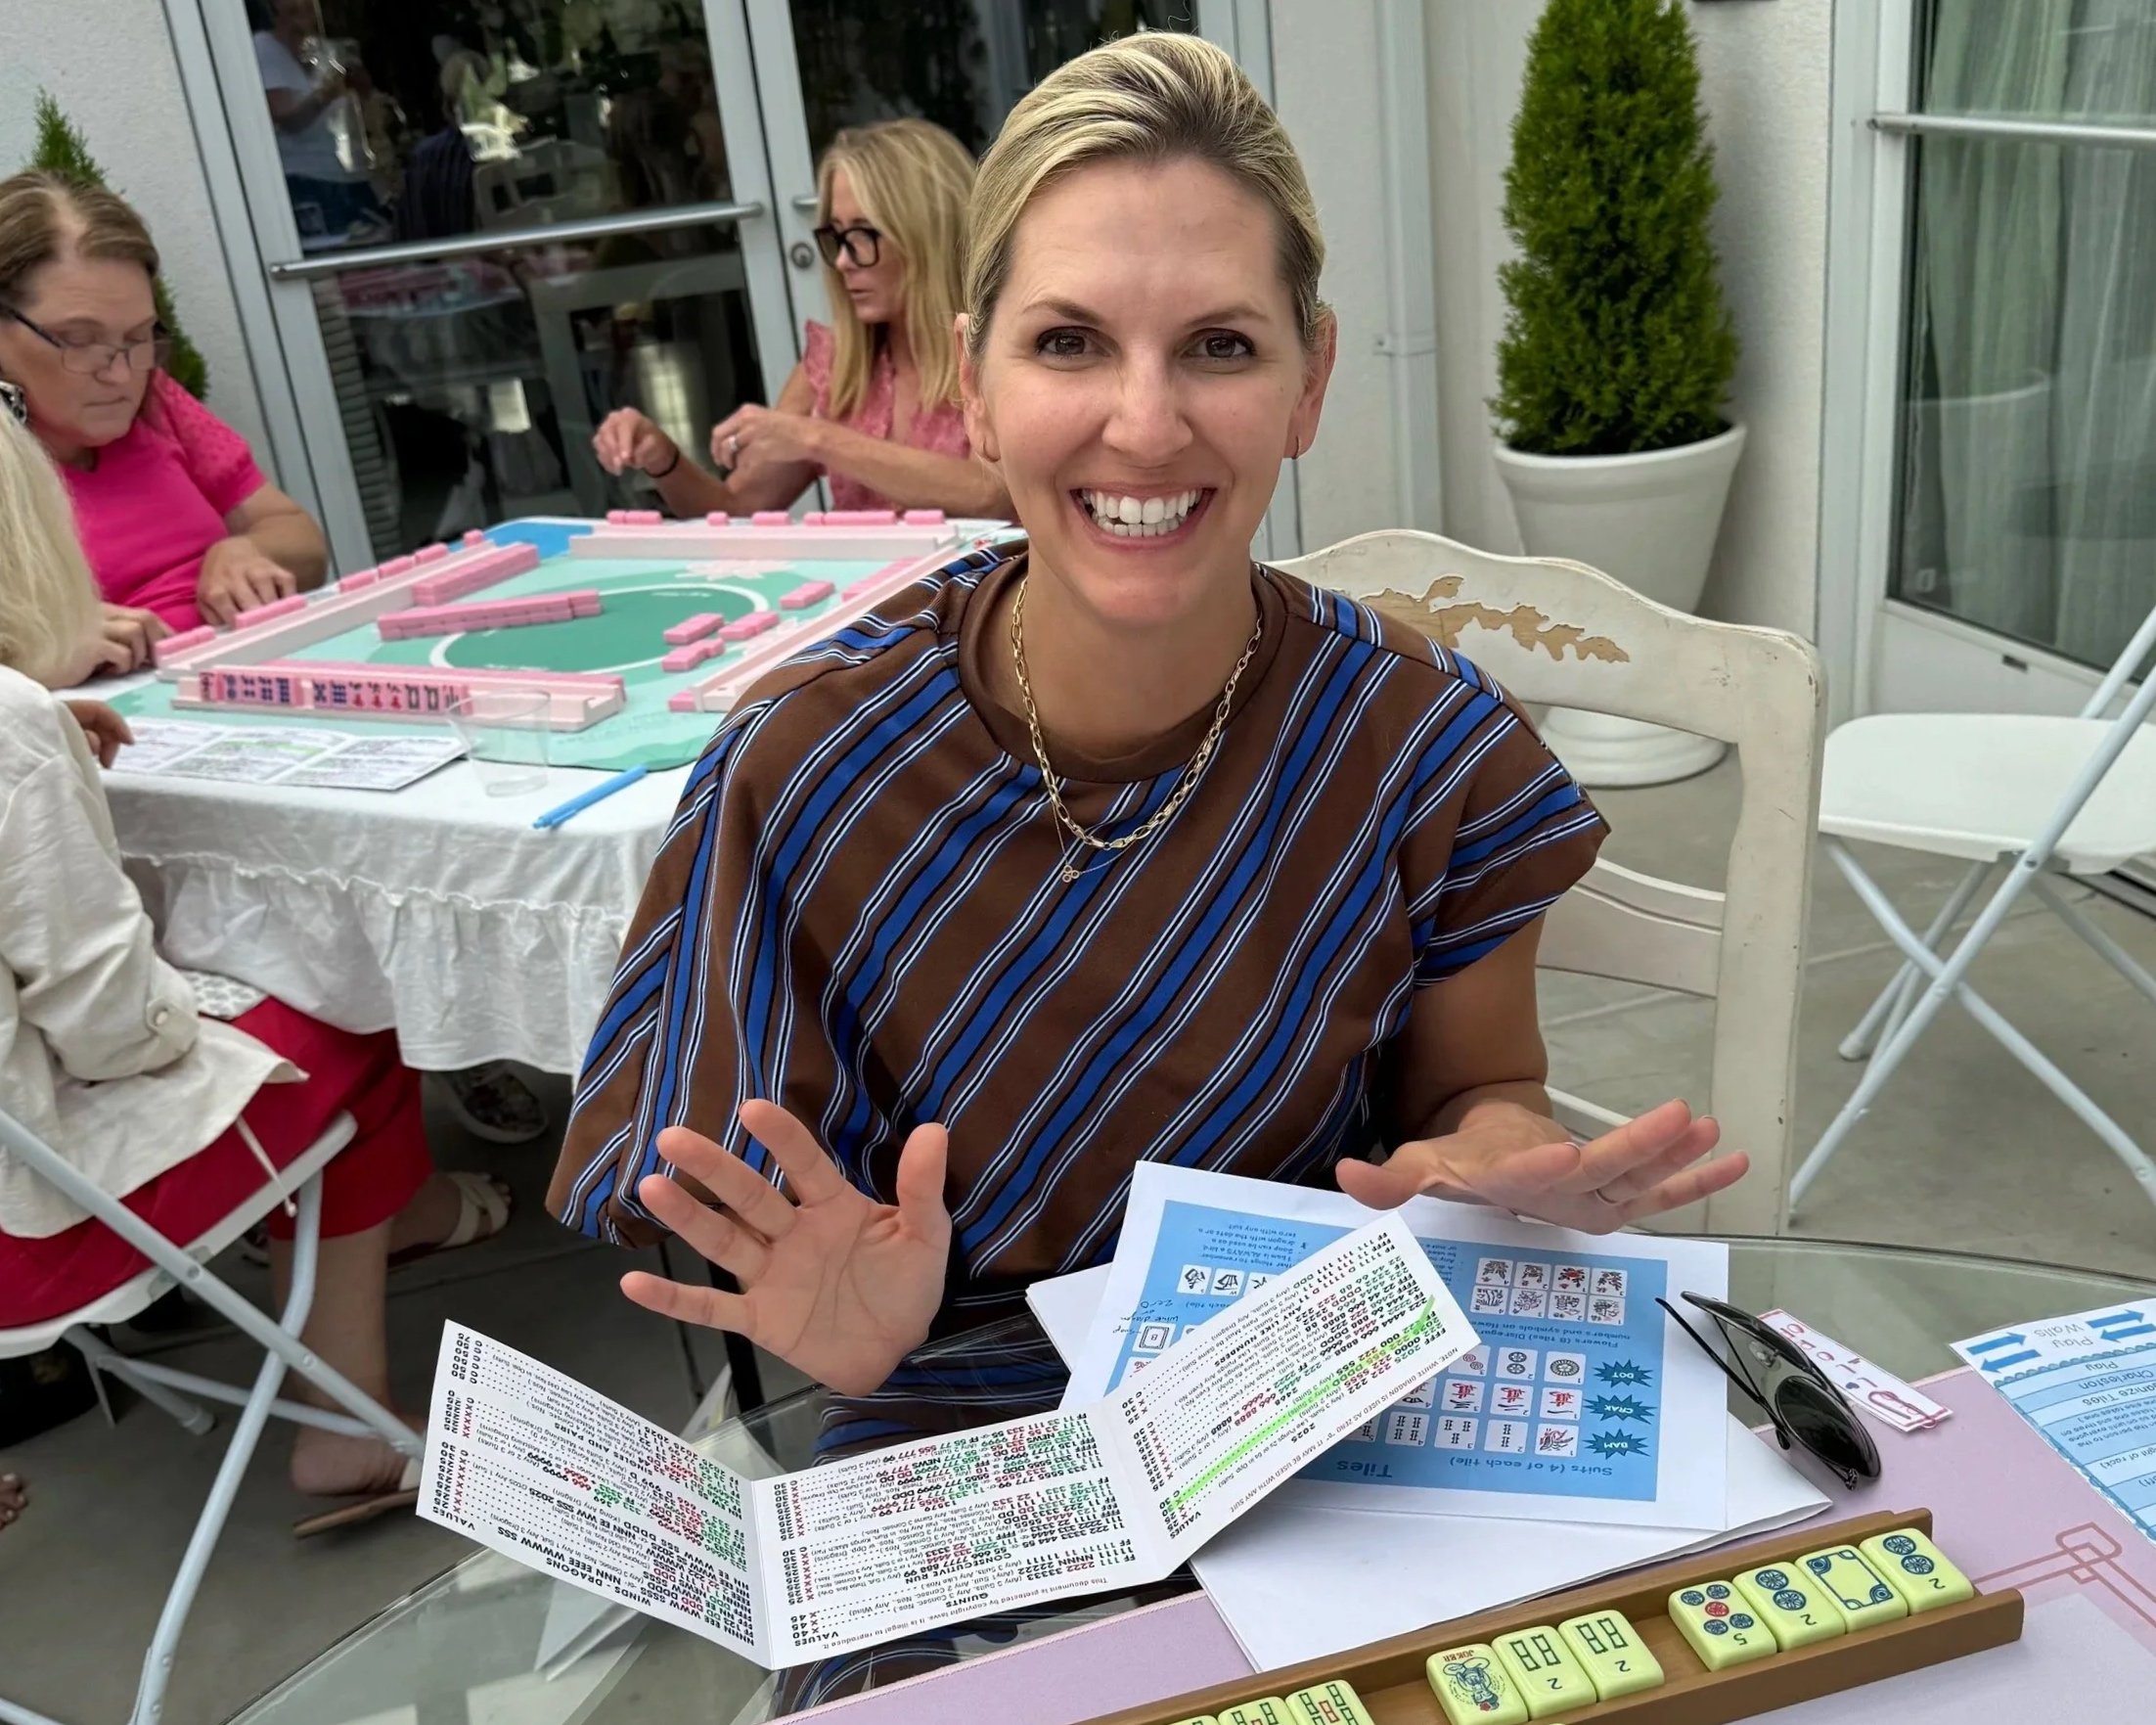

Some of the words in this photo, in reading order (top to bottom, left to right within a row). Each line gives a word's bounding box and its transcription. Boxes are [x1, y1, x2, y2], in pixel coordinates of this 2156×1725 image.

[1281, 1304, 1302, 1322] ANY
[1257, 1320, 1280, 1338] LIKE
[1474, 1330, 1525, 1339] Disregar
[2034, 1323, 2085, 1339] Walls
[1393, 1334, 1420, 1357] 0000
[1575, 1339, 1618, 1347] Flowers
[2051, 1336, 2093, 1349] Play
[1213, 1335, 1257, 1368] NUMBERS
[1370, 1360, 1391, 1380] 222
[2086, 1360, 2118, 1371] Play
[1330, 1362, 1363, 1387] DDDD
[1343, 1366, 1370, 1389] 5555
[2079, 1369, 2153, 1391] Charleston
[1347, 1376, 1368, 1395] 222
[1274, 1385, 1298, 1406] 2468
[2082, 1390, 2119, 1405] Tiles
[1604, 1404, 1634, 1414] CRAK
[554, 1421, 583, 1441] PAIRS
[1025, 1431, 1055, 1443] NEWS
[1289, 1422, 1316, 1444] 2025
[587, 1437, 609, 1454] AND
[1603, 1440, 1629, 1449] BAM
[613, 1450, 651, 1475] SINGLES
[911, 1456, 941, 1469] NEWS
[1450, 1457, 1480, 1466] tile)
[1550, 1464, 1565, 1474] (4
[1336, 1461, 1392, 1479] Tiles
[1571, 1466, 1612, 1475] Suits
[593, 1494, 611, 1509] 369
[922, 1499, 956, 1512] 13579
[431, 1505, 475, 1530] VALUES
[1168, 1509, 1201, 1539] VALUES
[497, 1525, 517, 1541] SSS
[623, 1520, 655, 1541] DDDD
[520, 1535, 564, 1562] WWWW
[568, 1556, 592, 1573] EEEE
[928, 1552, 1011, 1577] CONSECUTIVE
[1057, 1552, 1094, 1566] NNNN
[1065, 1560, 1095, 1572] 2222
[546, 1557, 602, 1587] DRAGONS
[596, 1566, 620, 1585] NNN
[1016, 1561, 1054, 1575] 22222
[1025, 1566, 1062, 1581] 33333
[905, 1572, 928, 1584] RUN
[1928, 1577, 1945, 1589] 2
[614, 1584, 651, 1607] WINDS
[647, 1580, 678, 1600] DDDD
[681, 1595, 703, 1612] DDD
[944, 1591, 988, 1608] QUINTS
[790, 1620, 807, 1631] 45
[1800, 1613, 1817, 1626] 2
[791, 1628, 809, 1639] 40
[793, 1630, 838, 1647] VALUES
[1732, 1633, 1747, 1646] 5
[1615, 1660, 1631, 1672] 2
[1547, 1677, 1563, 1690] 2
